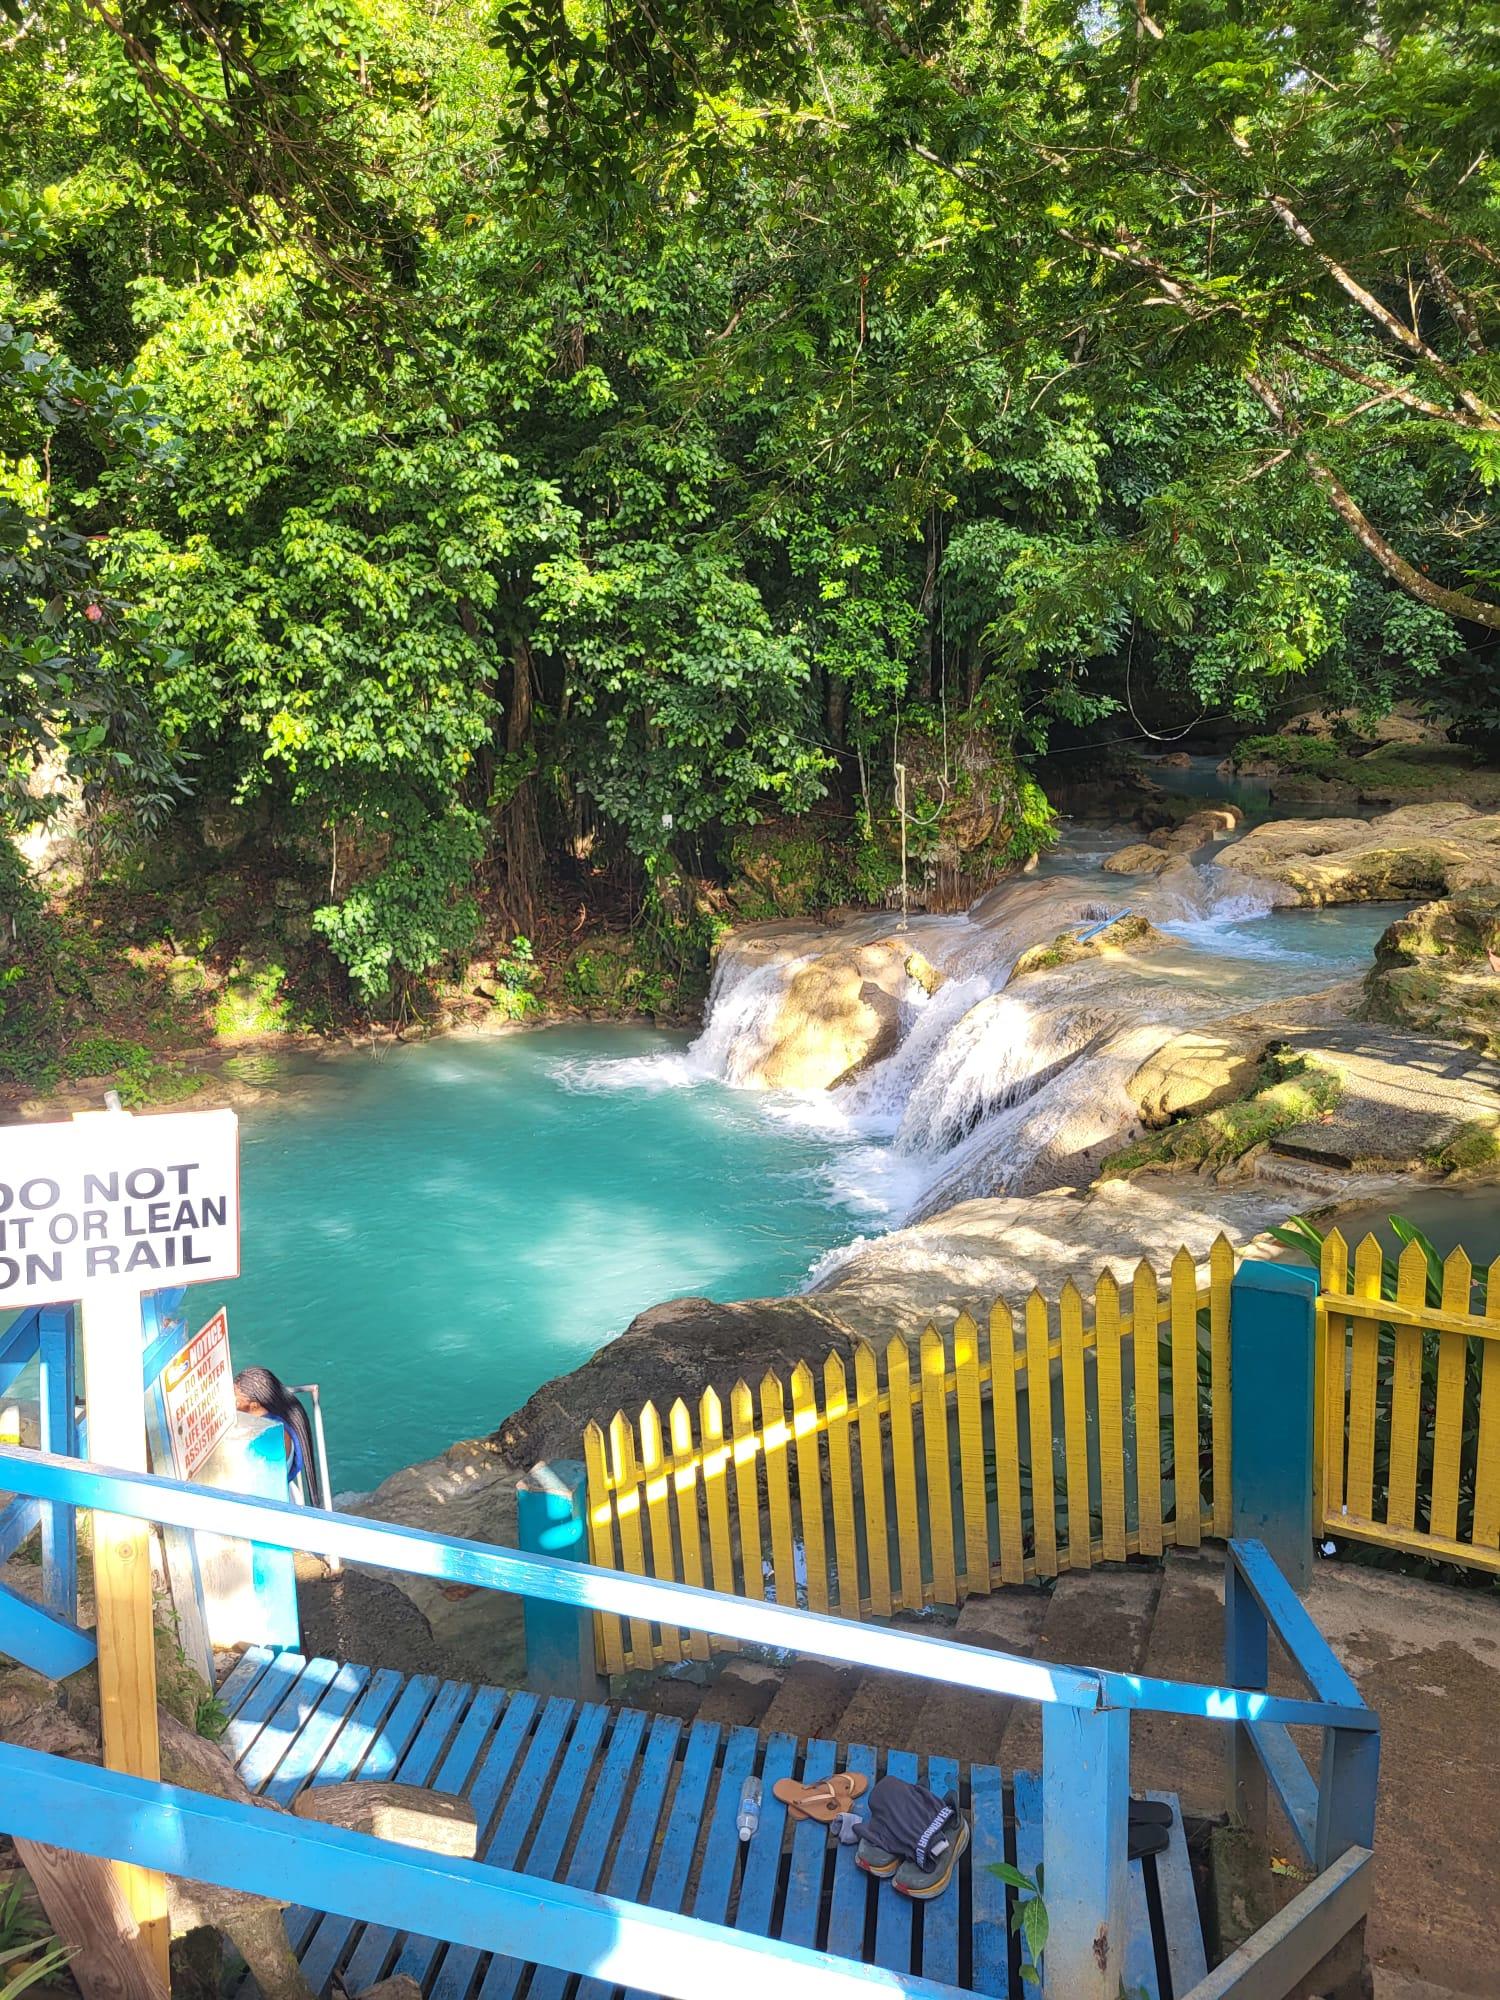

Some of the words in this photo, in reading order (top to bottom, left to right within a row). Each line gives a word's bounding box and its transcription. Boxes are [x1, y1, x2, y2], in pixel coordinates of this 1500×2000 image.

[84, 1163, 199, 1204] NOT
[49, 1210, 108, 1245] OR
[124, 1196, 227, 1237] LEAN
[86, 1235, 211, 1277] RAIL
[189, 1320, 223, 1368] NOTICE
[175, 1390, 199, 1421] ENTER
[200, 1360, 225, 1394] WATER
[184, 1374, 196, 1394] DO
[197, 1355, 212, 1382] NOT
[186, 1382, 220, 1428] WITHOUT
[184, 1423, 200, 1449] LIFE
[917, 1815, 944, 1848] ARMOUR
